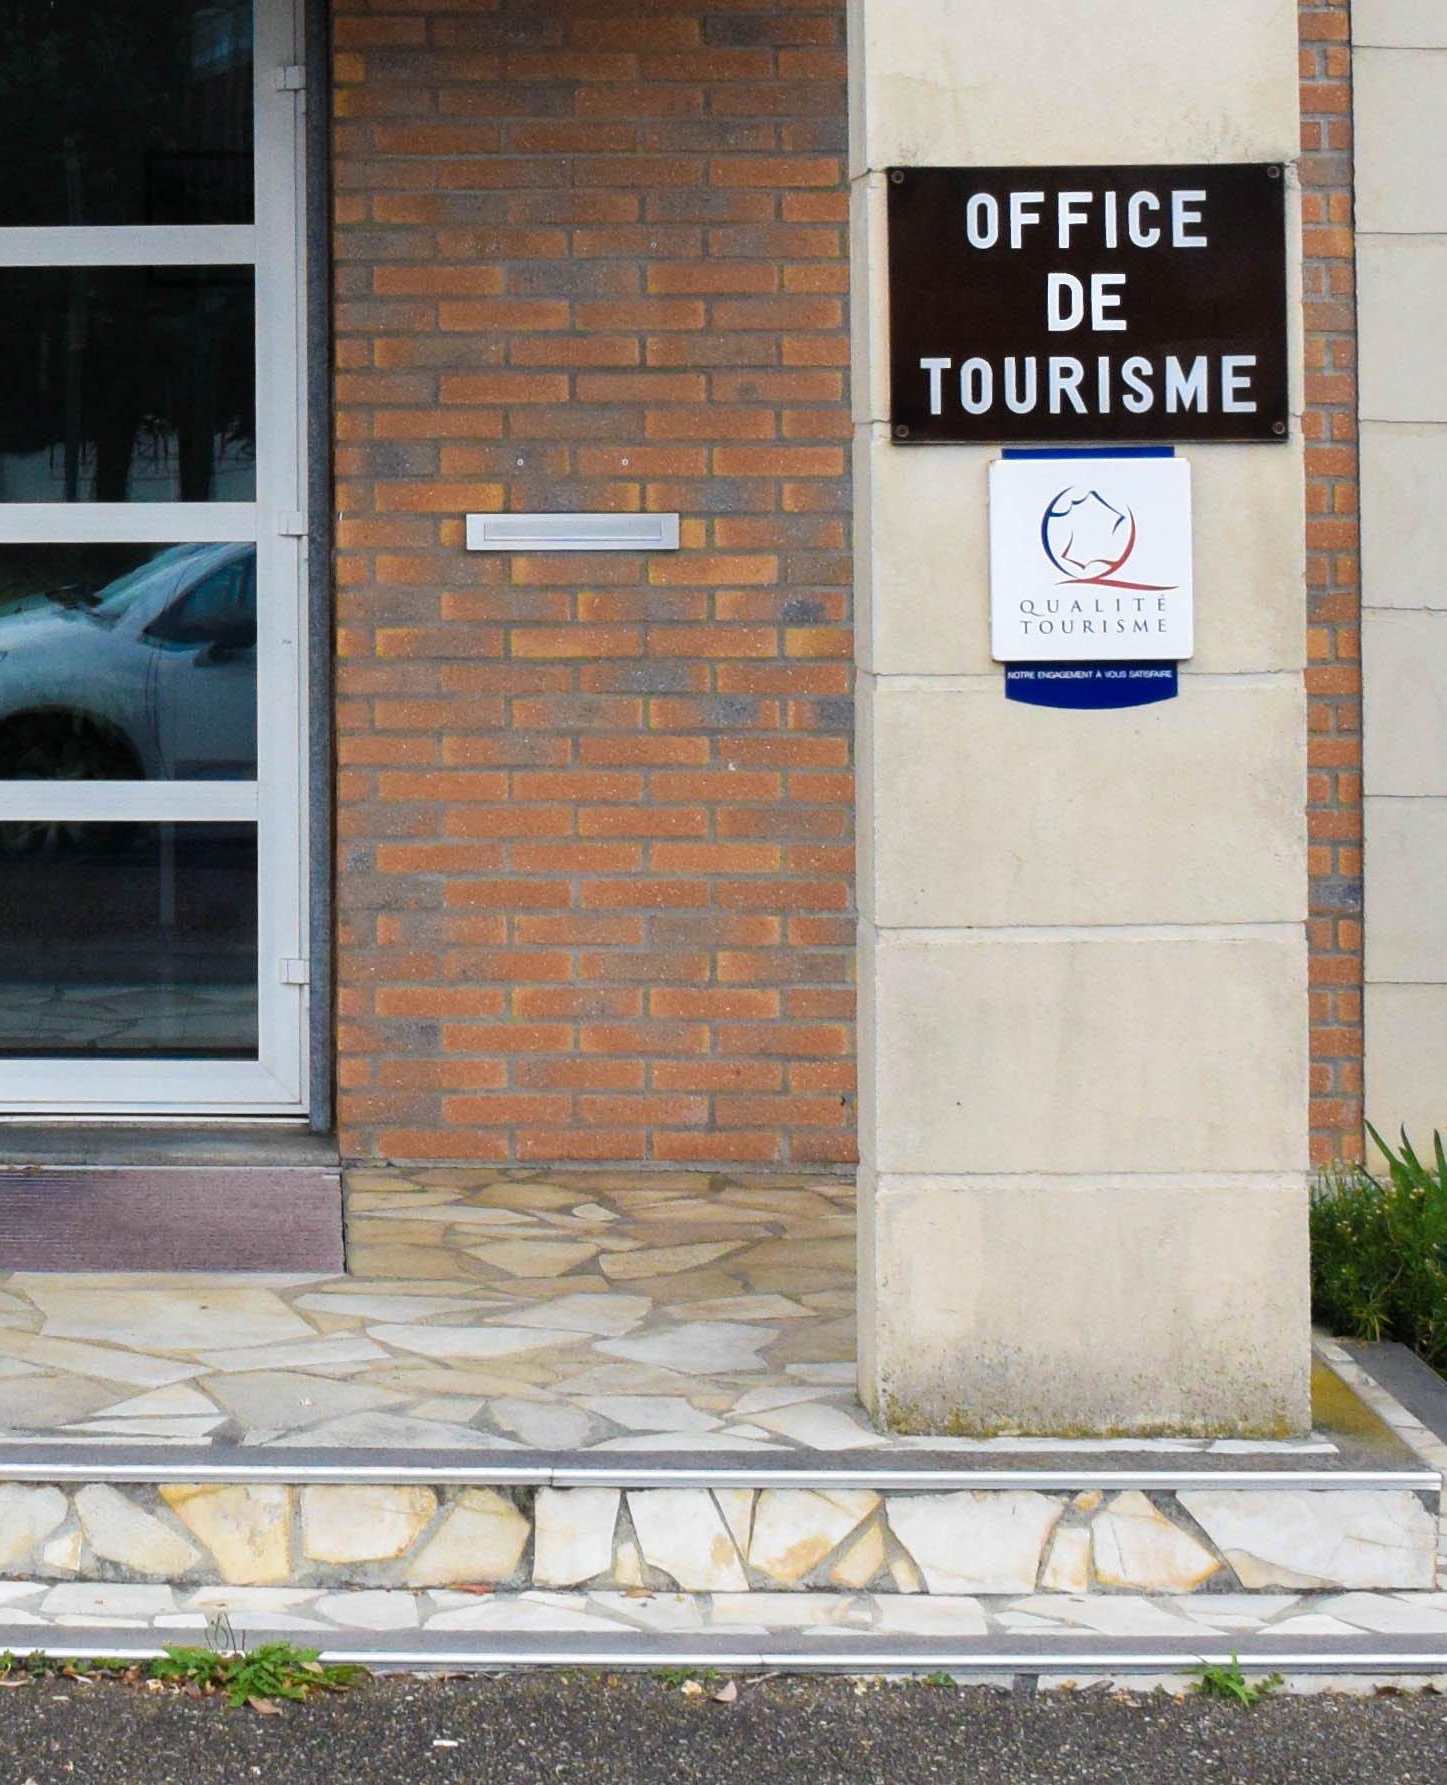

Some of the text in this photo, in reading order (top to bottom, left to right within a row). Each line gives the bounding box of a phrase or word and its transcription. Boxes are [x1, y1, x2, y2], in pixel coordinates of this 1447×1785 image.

[966, 190, 1208, 249] OFFICE
[1046, 272, 1127, 332] DE
[919, 354, 1258, 415] TOURISME
[1019, 594, 1167, 617] QUALITÉ
[1019, 618, 1167, 635] TOURISME
[1007, 669, 1173, 680] NOTRE ENGAGEMENT À VOUS SATISFAIRE
